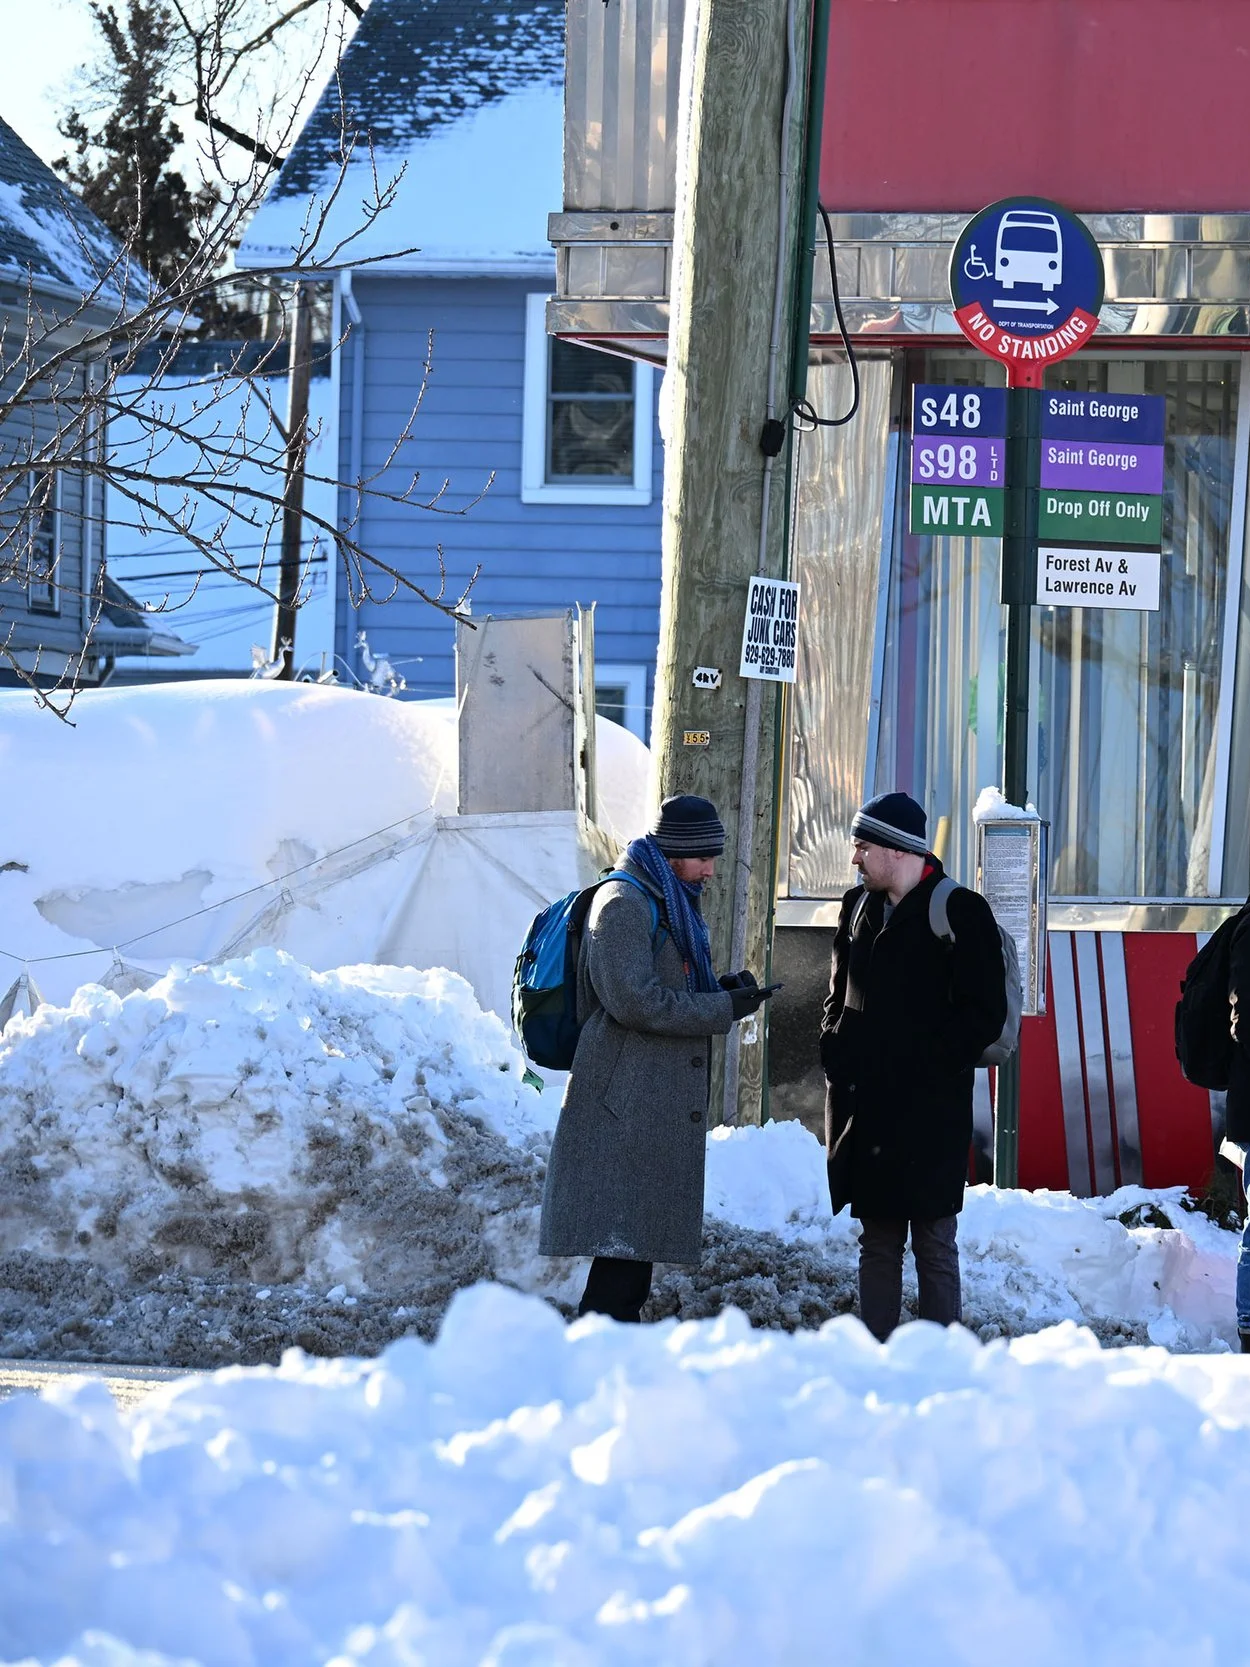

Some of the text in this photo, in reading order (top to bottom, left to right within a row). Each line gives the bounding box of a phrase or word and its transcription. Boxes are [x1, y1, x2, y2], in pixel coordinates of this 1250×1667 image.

[968, 311, 1088, 360] NO STANDING
[1017, 322, 1054, 330] TRANSPORTATION
[921, 393, 981, 428] S48
[1049, 398, 1139, 422] Saint George
[919, 444, 977, 480] S98
[990, 446, 998, 481] LTD
[1048, 447, 1138, 471] Saint George
[923, 496, 991, 527] MTA
[1047, 498, 1150, 522] Drop Off Only
[1046, 555, 1129, 574] Forest Av &
[1045, 577, 1136, 596] Lawrence Av
[778, 588, 798, 621] FOR
[747, 616, 796, 649] JUNK CARS
[744, 644, 795, 669] 929-629-7880
